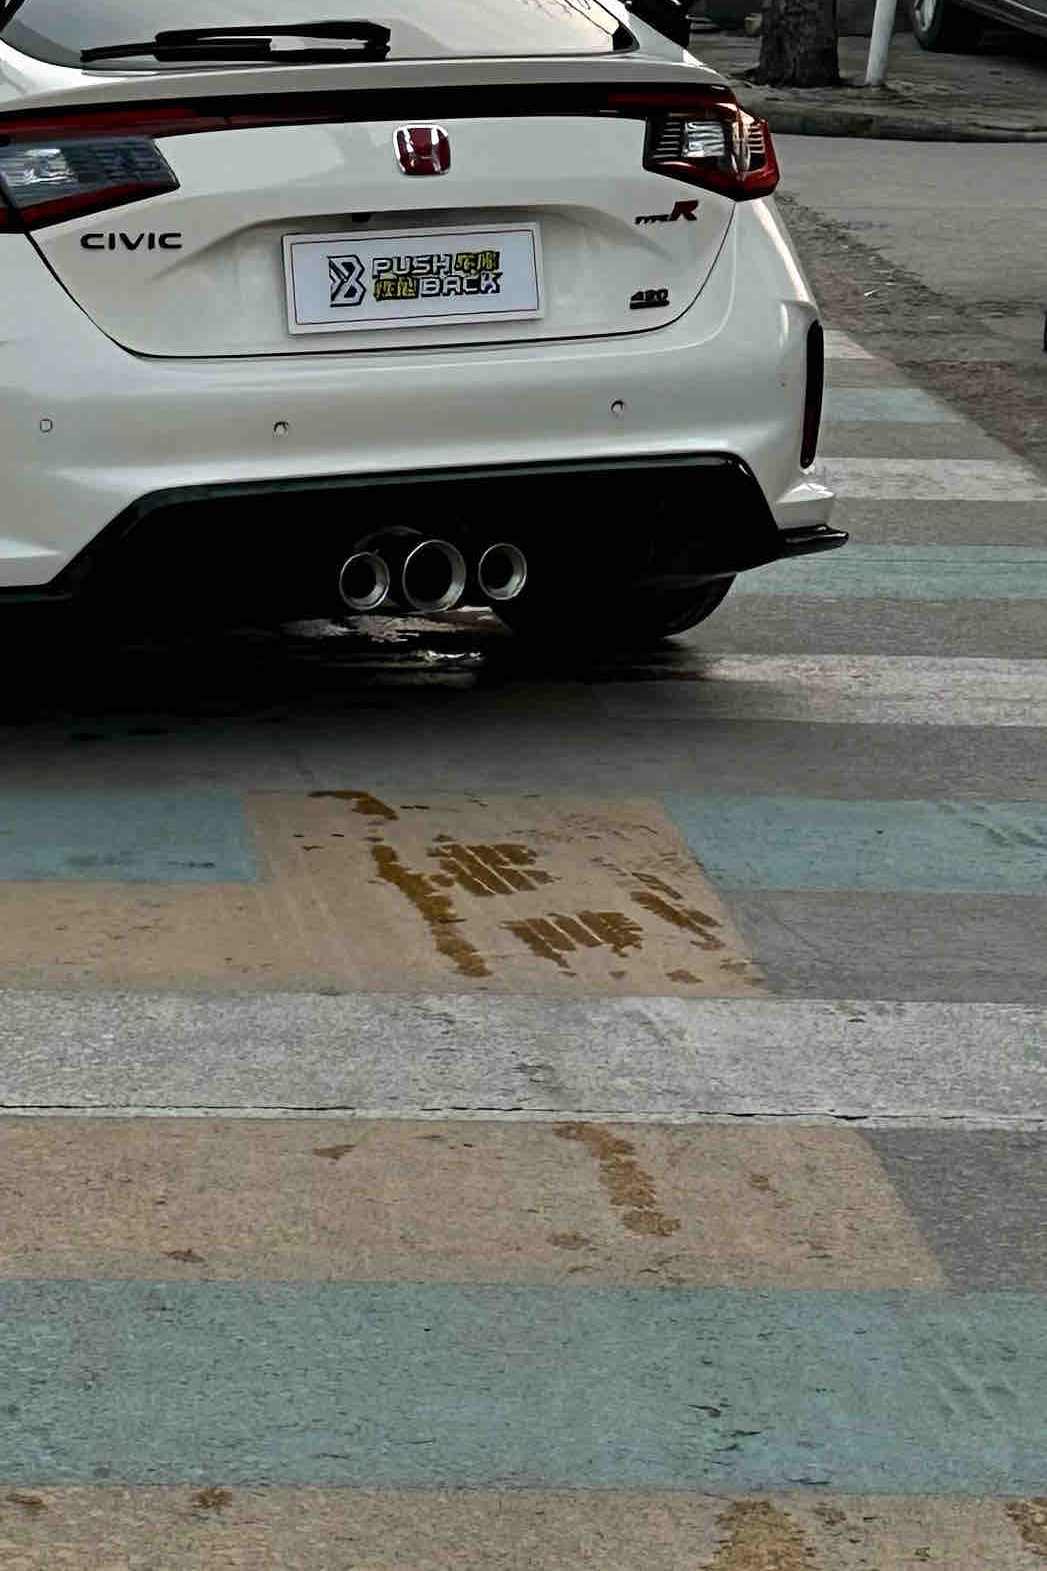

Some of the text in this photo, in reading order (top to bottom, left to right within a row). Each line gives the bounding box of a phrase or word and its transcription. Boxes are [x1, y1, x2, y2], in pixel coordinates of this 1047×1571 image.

[80, 232, 183, 251] CIVIC
[372, 254, 454, 279] PUSH
[420, 272, 503, 298] BACK
